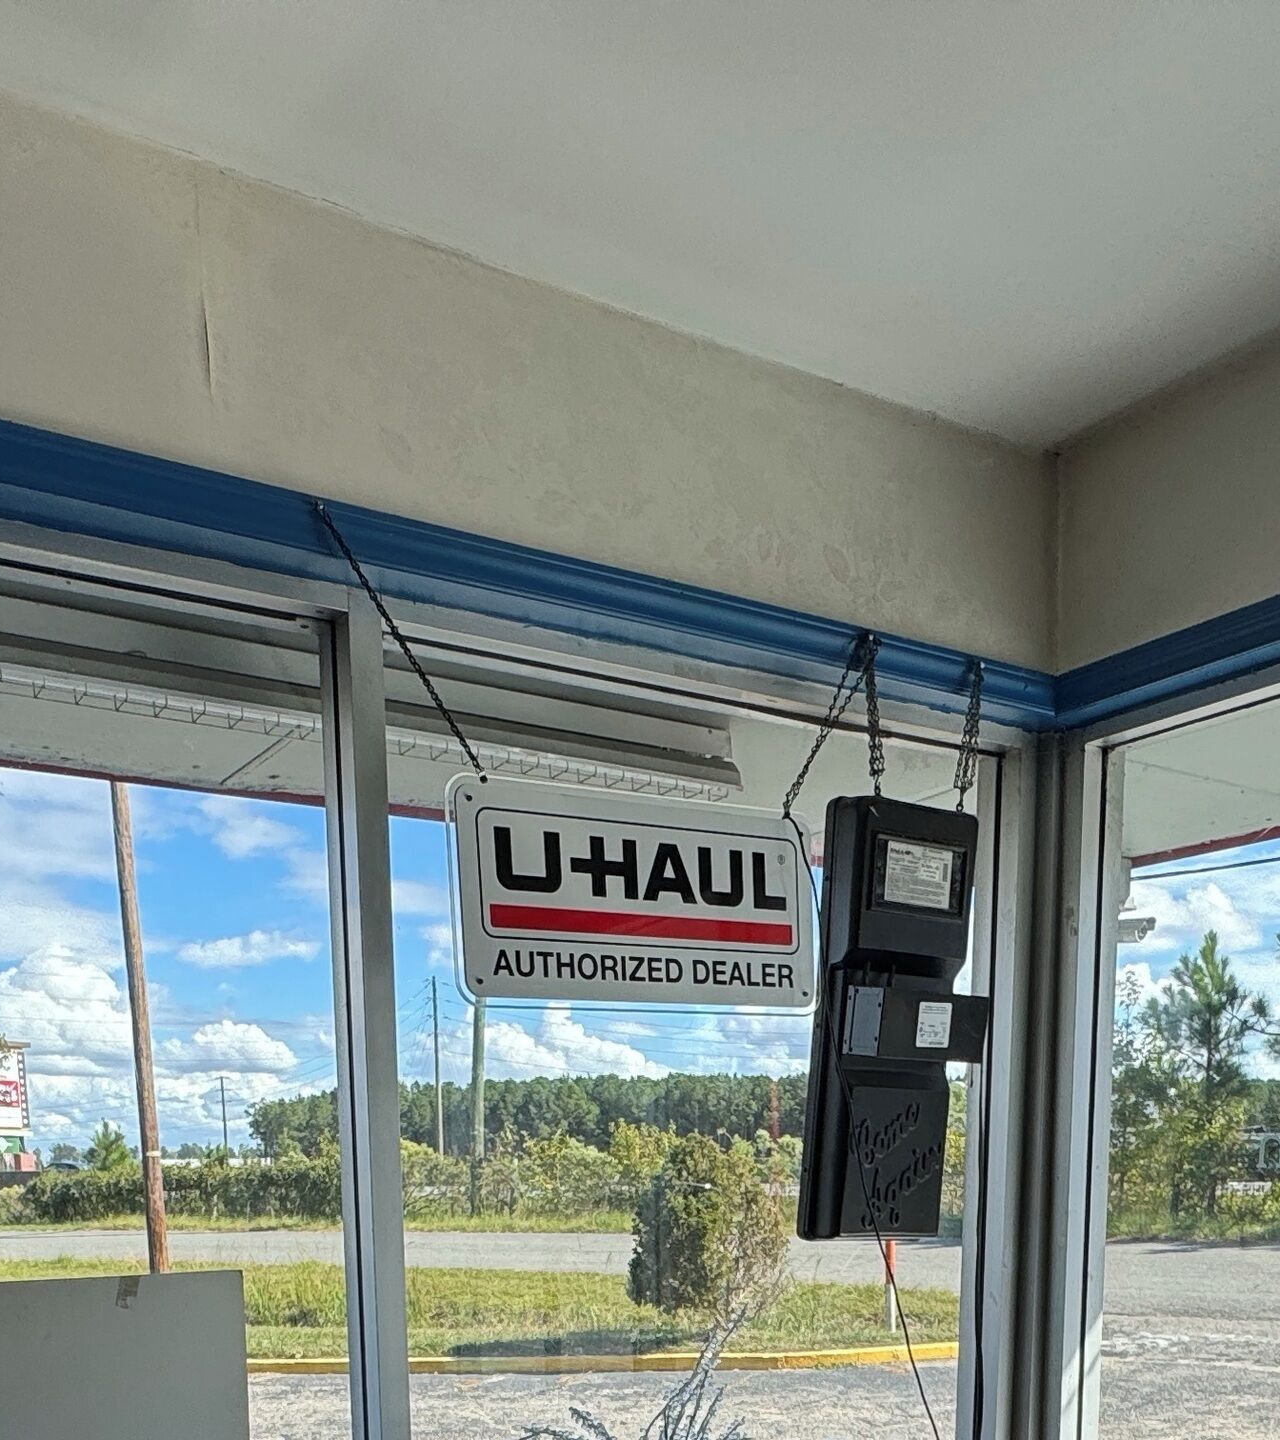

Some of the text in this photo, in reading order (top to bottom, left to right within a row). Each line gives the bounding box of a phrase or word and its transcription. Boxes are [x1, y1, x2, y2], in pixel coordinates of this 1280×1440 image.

[493, 826, 787, 911] U-HAUL
[493, 949, 795, 988] AUTHORIZED DEALER
